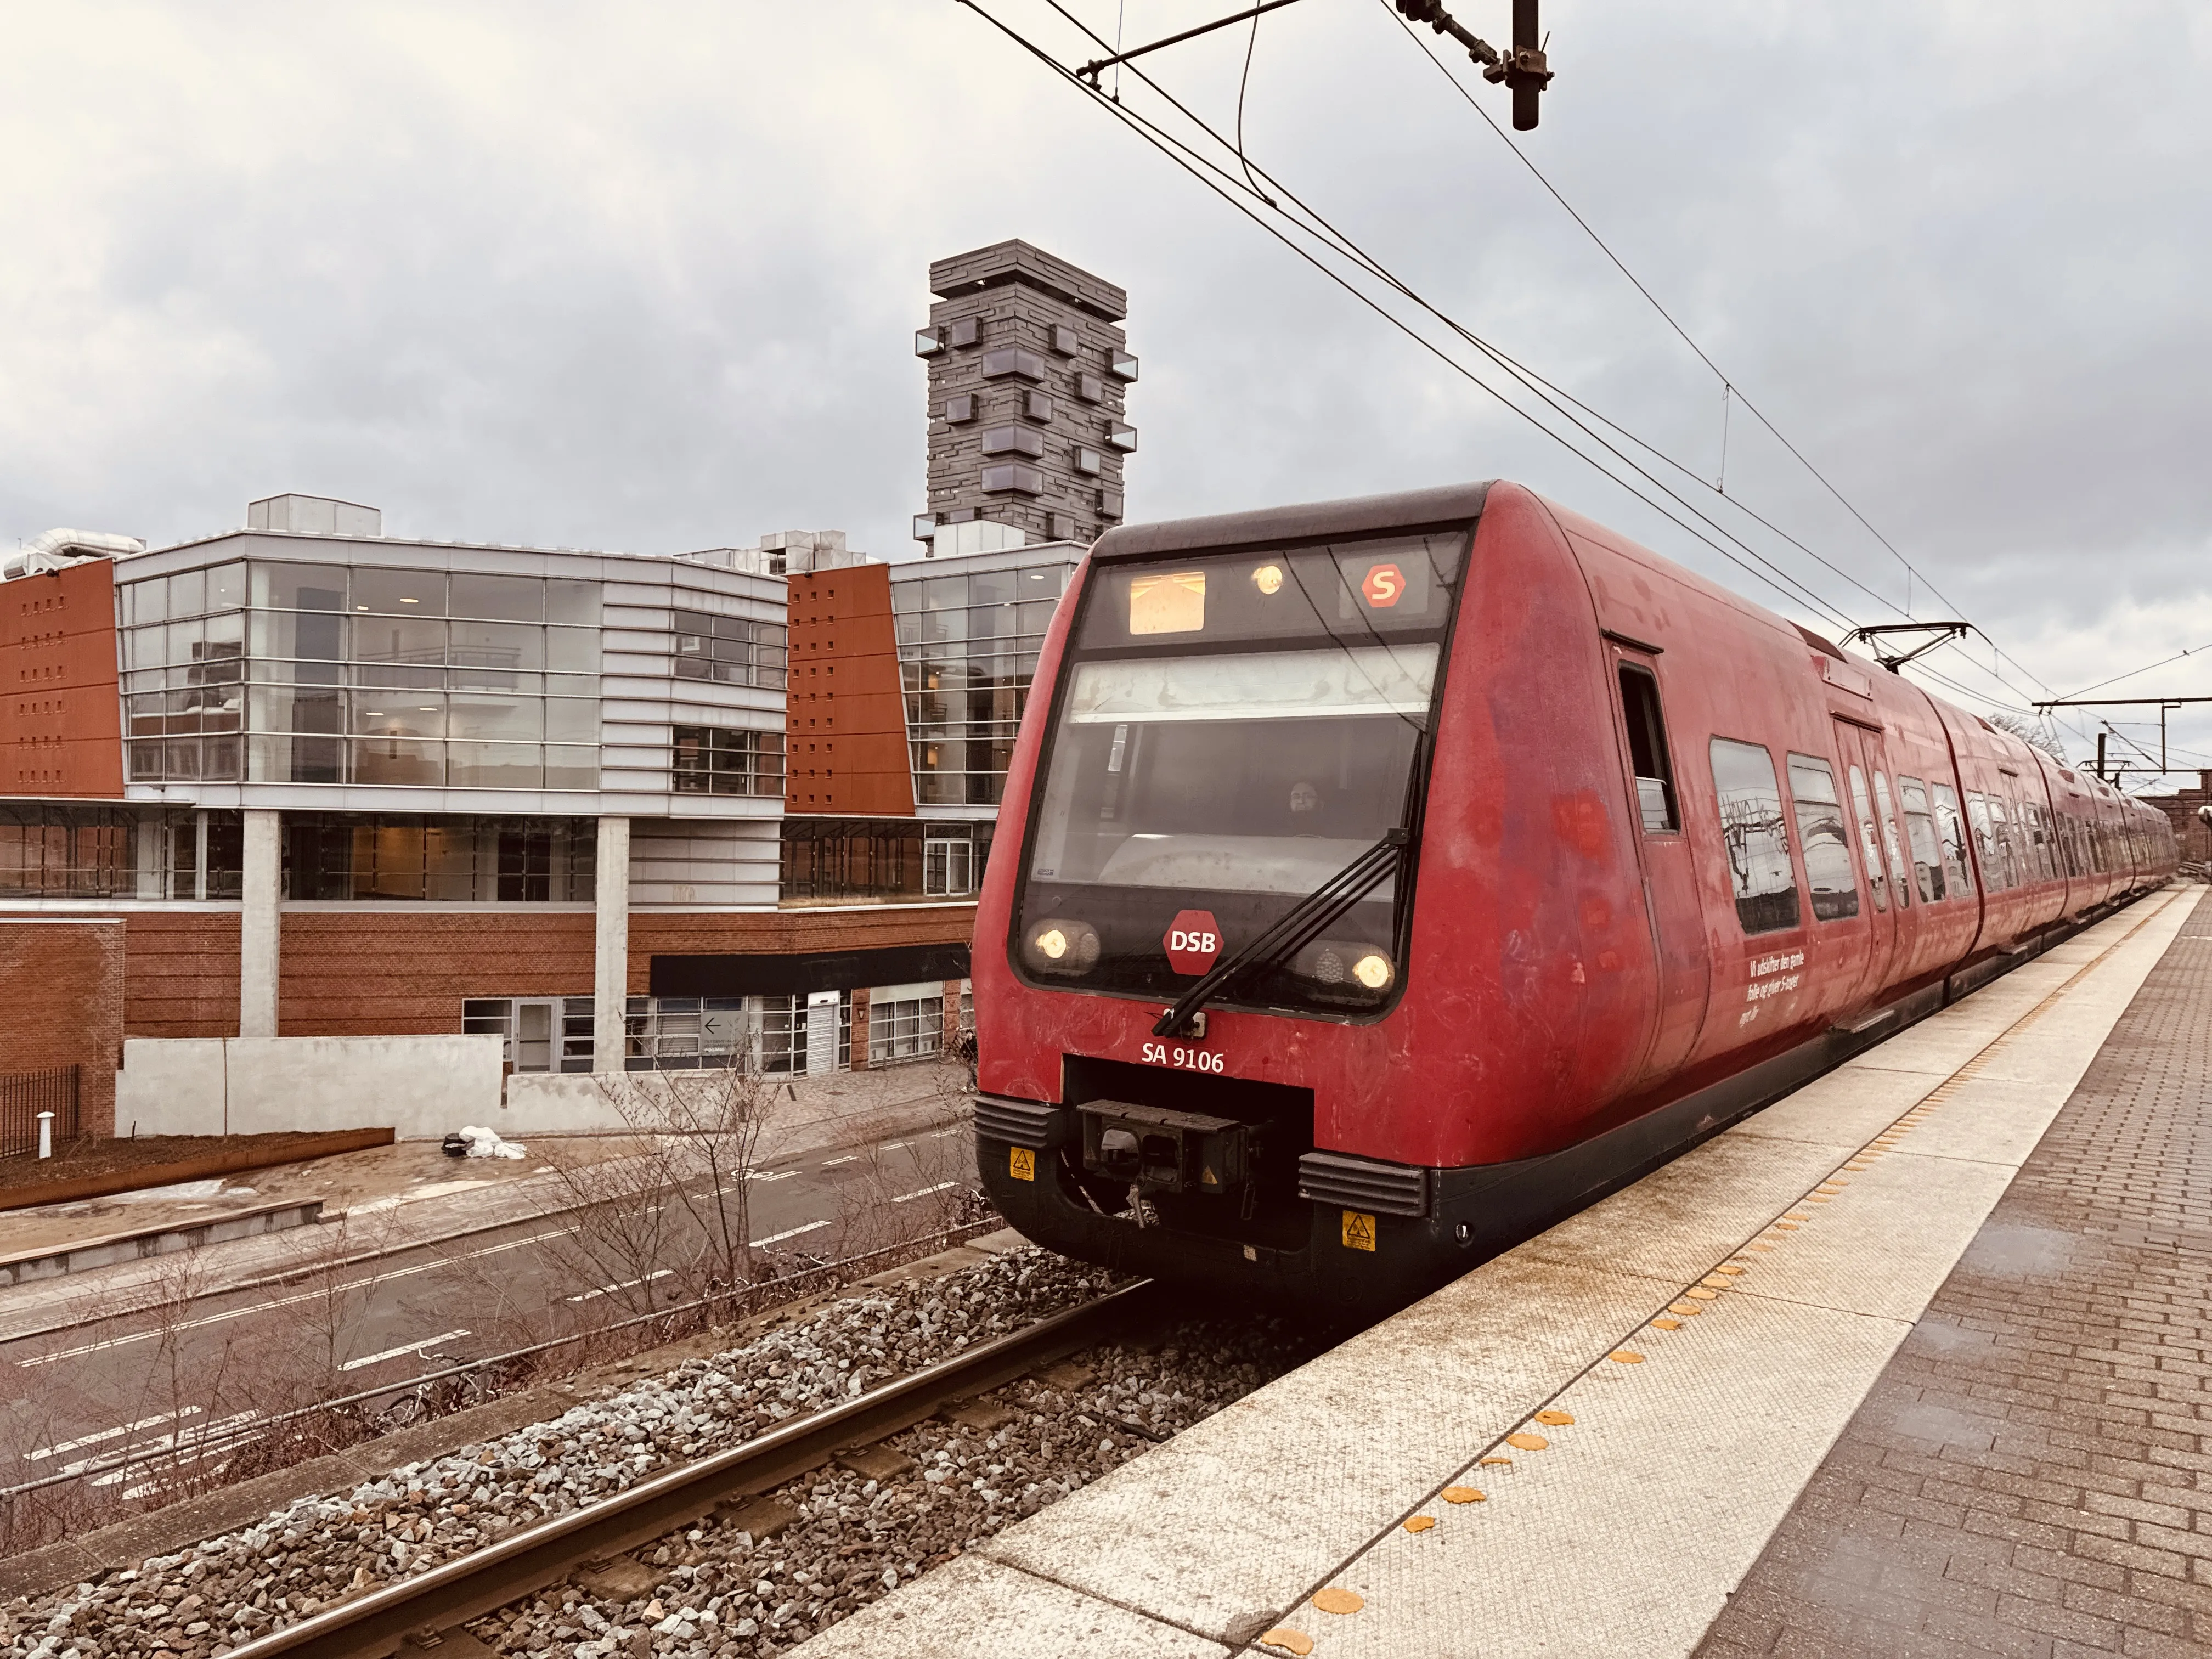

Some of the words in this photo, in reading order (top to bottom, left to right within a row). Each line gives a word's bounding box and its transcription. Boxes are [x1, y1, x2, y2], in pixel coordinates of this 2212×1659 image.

[1372, 571, 1395, 599] S
[1171, 930, 1216, 953] DSB
[1750, 961, 1756, 978] Vi
[1780, 953, 1790, 970] den
[1142, 1043, 1167, 1064] SA
[1173, 1047, 1224, 1073] 9106
